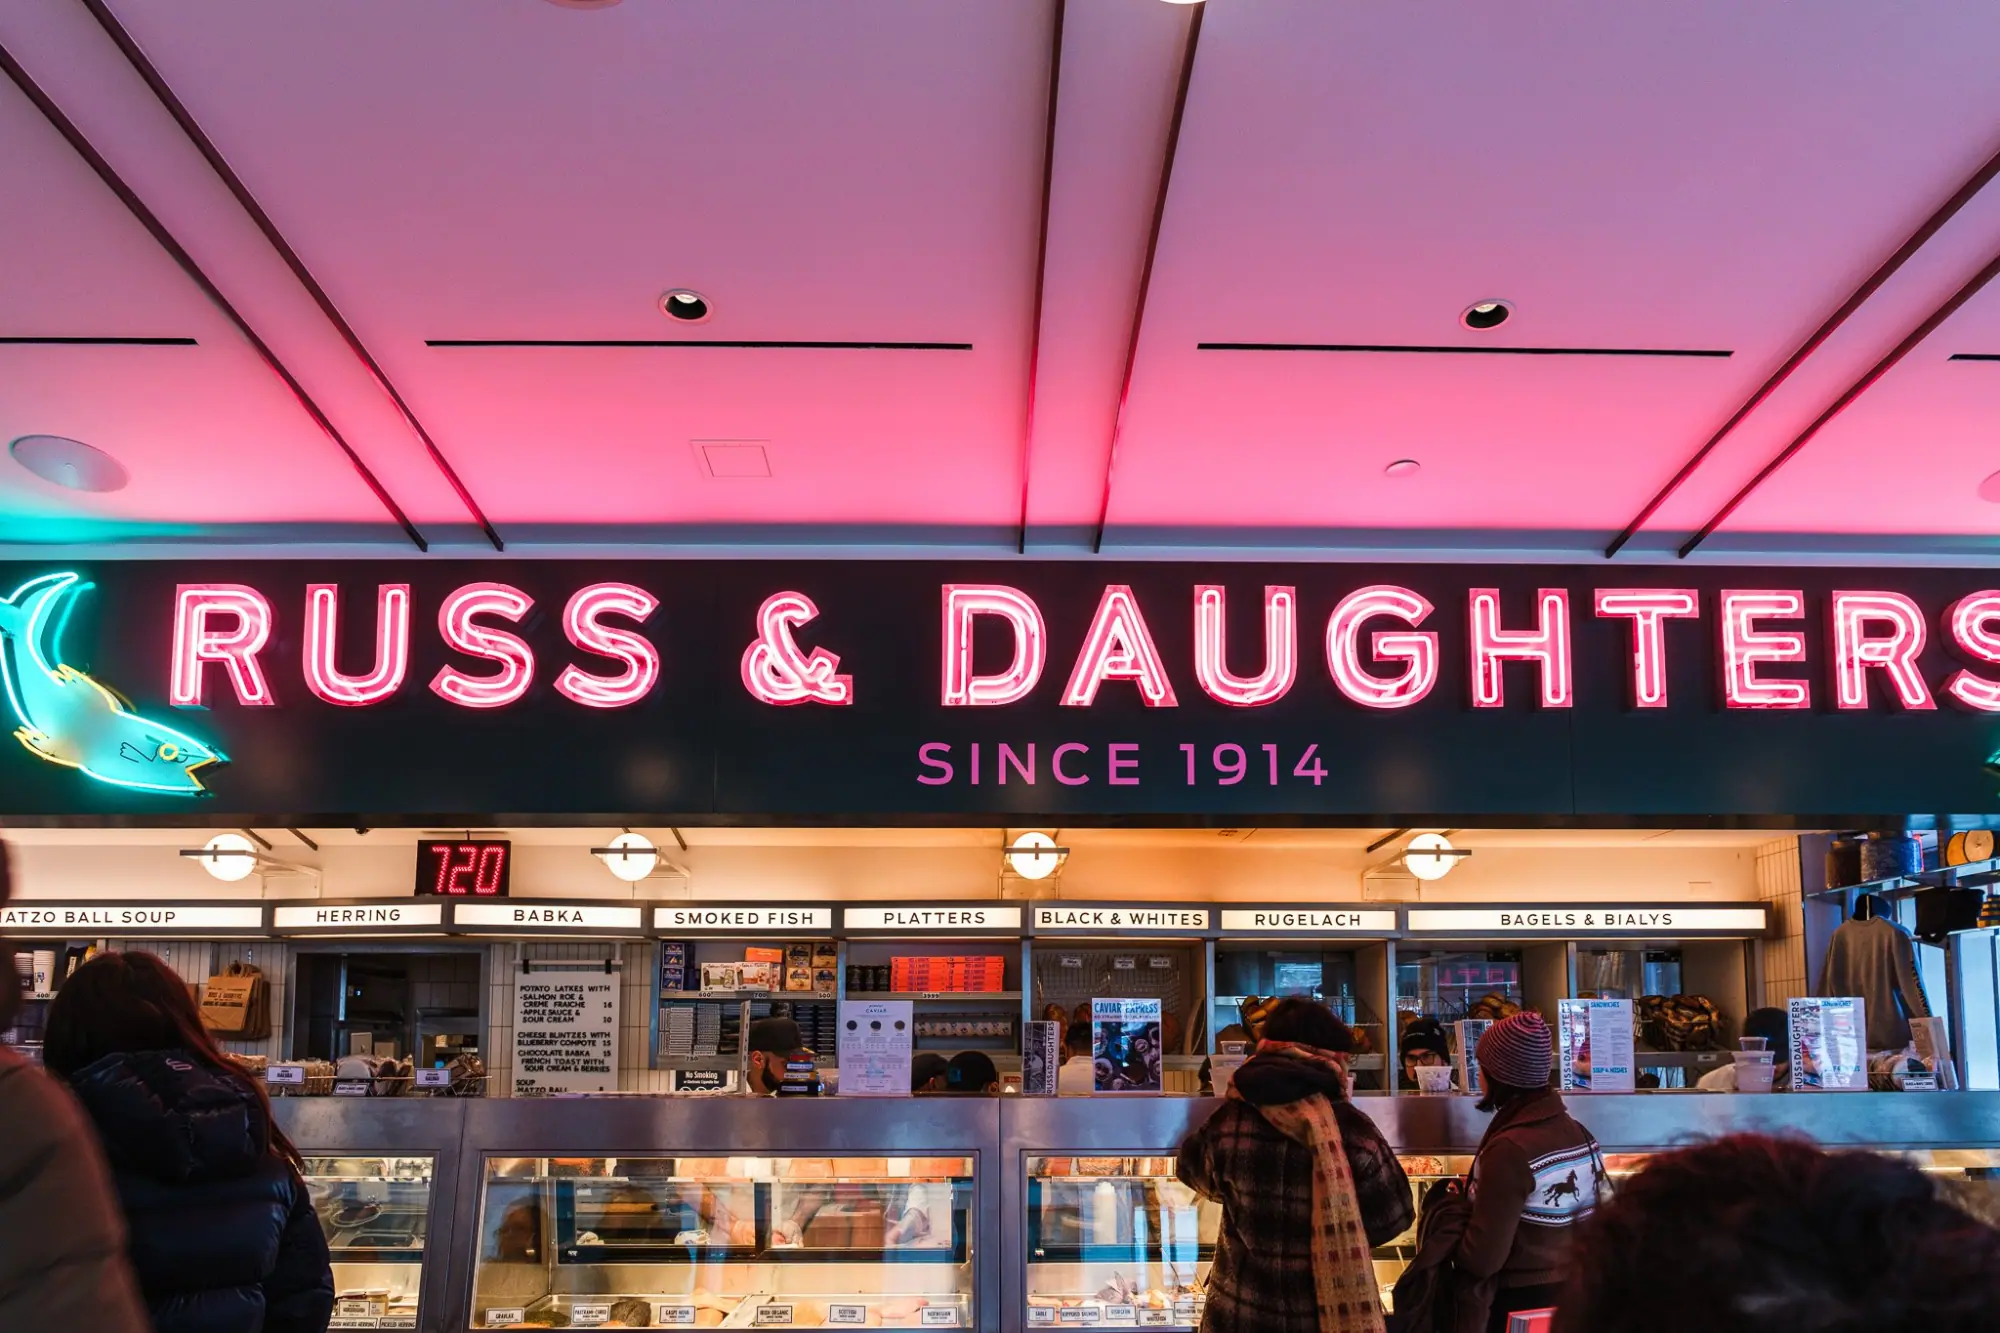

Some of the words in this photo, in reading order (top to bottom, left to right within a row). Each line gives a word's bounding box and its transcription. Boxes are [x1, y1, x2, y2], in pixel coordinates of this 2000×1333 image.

[170, 583, 659, 708] RUSS
[741, 591, 853, 706] &
[917, 742, 1140, 786] SINCE
[1179, 743, 1329, 786] 1914
[431, 845, 505, 895] 720
[0, 911, 56, 924] ATZO
[64, 911, 113, 924] BALL
[121, 911, 176, 924] SOUP
[316, 910, 401, 922] HERRING
[513, 910, 584, 923] BABKA
[674, 912, 759, 925] SMOKED
[768, 912, 813, 925] FISH
[884, 911, 985, 925] PLATTERS
[1041, 911, 1103, 925] BLACK
[1110, 912, 1121, 925] &
[1129, 912, 1203, 926] WHITES
[1255, 912, 1361, 927] RUGELACH
[1501, 913, 1576, 926] BAGELS
[1584, 913, 1595, 926] &
[1604, 913, 1672, 926] BIALYS
[1094, 1002, 1122, 1014] CAVIAR
[1126, 1002, 1158, 1014] EXPRESS
[694, 1071, 718, 1080] Smoking
